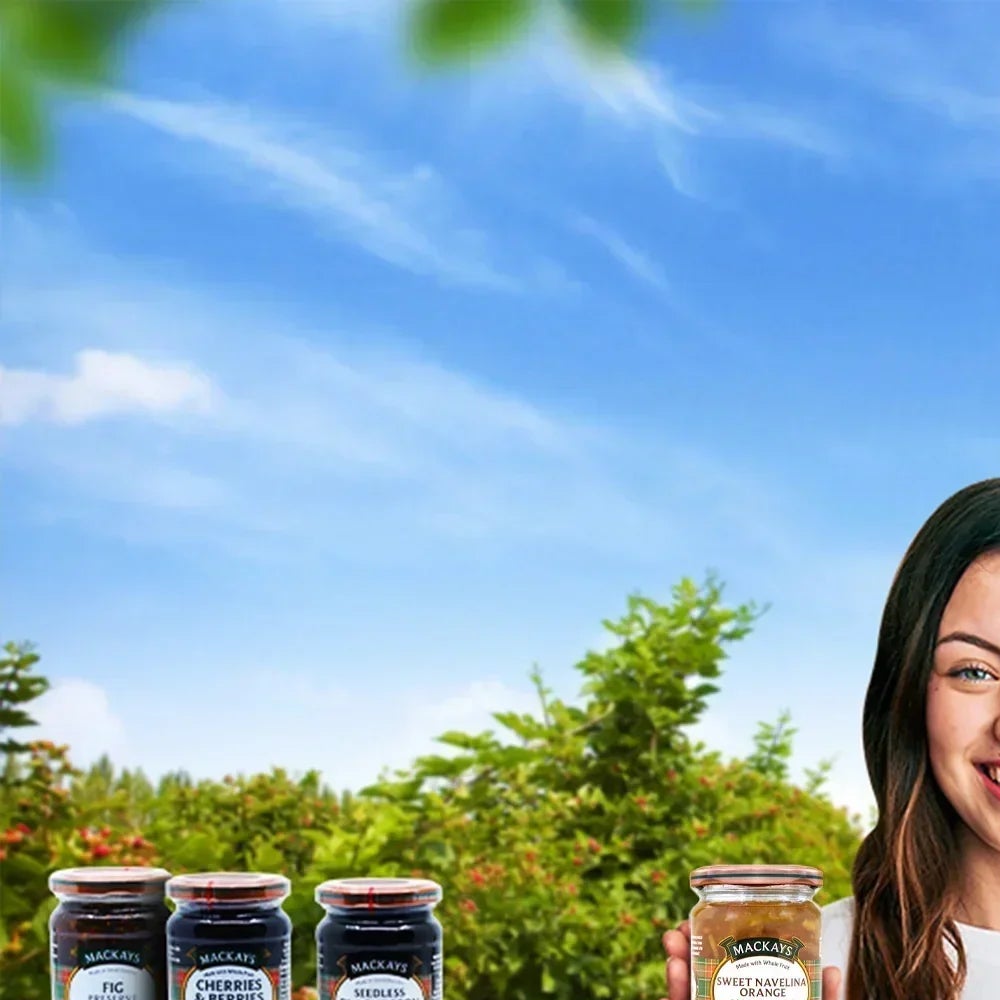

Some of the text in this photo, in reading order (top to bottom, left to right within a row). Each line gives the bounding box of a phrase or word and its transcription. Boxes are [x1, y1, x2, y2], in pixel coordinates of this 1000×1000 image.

[732, 941, 793, 956] MACKAYS
[85, 949, 140, 964] MACKAYS
[200, 951, 256, 964] MACKAYS
[351, 959, 408, 973] MACKAYS
[735, 962, 749, 970] Made
[102, 981, 124, 993] FIG
[195, 978, 262, 992] CHERRIES
[716, 977, 807, 988] SWEET NAVELINA
[354, 988, 405, 998] SEEDLESS
[739, 988, 786, 997] ORANGE
